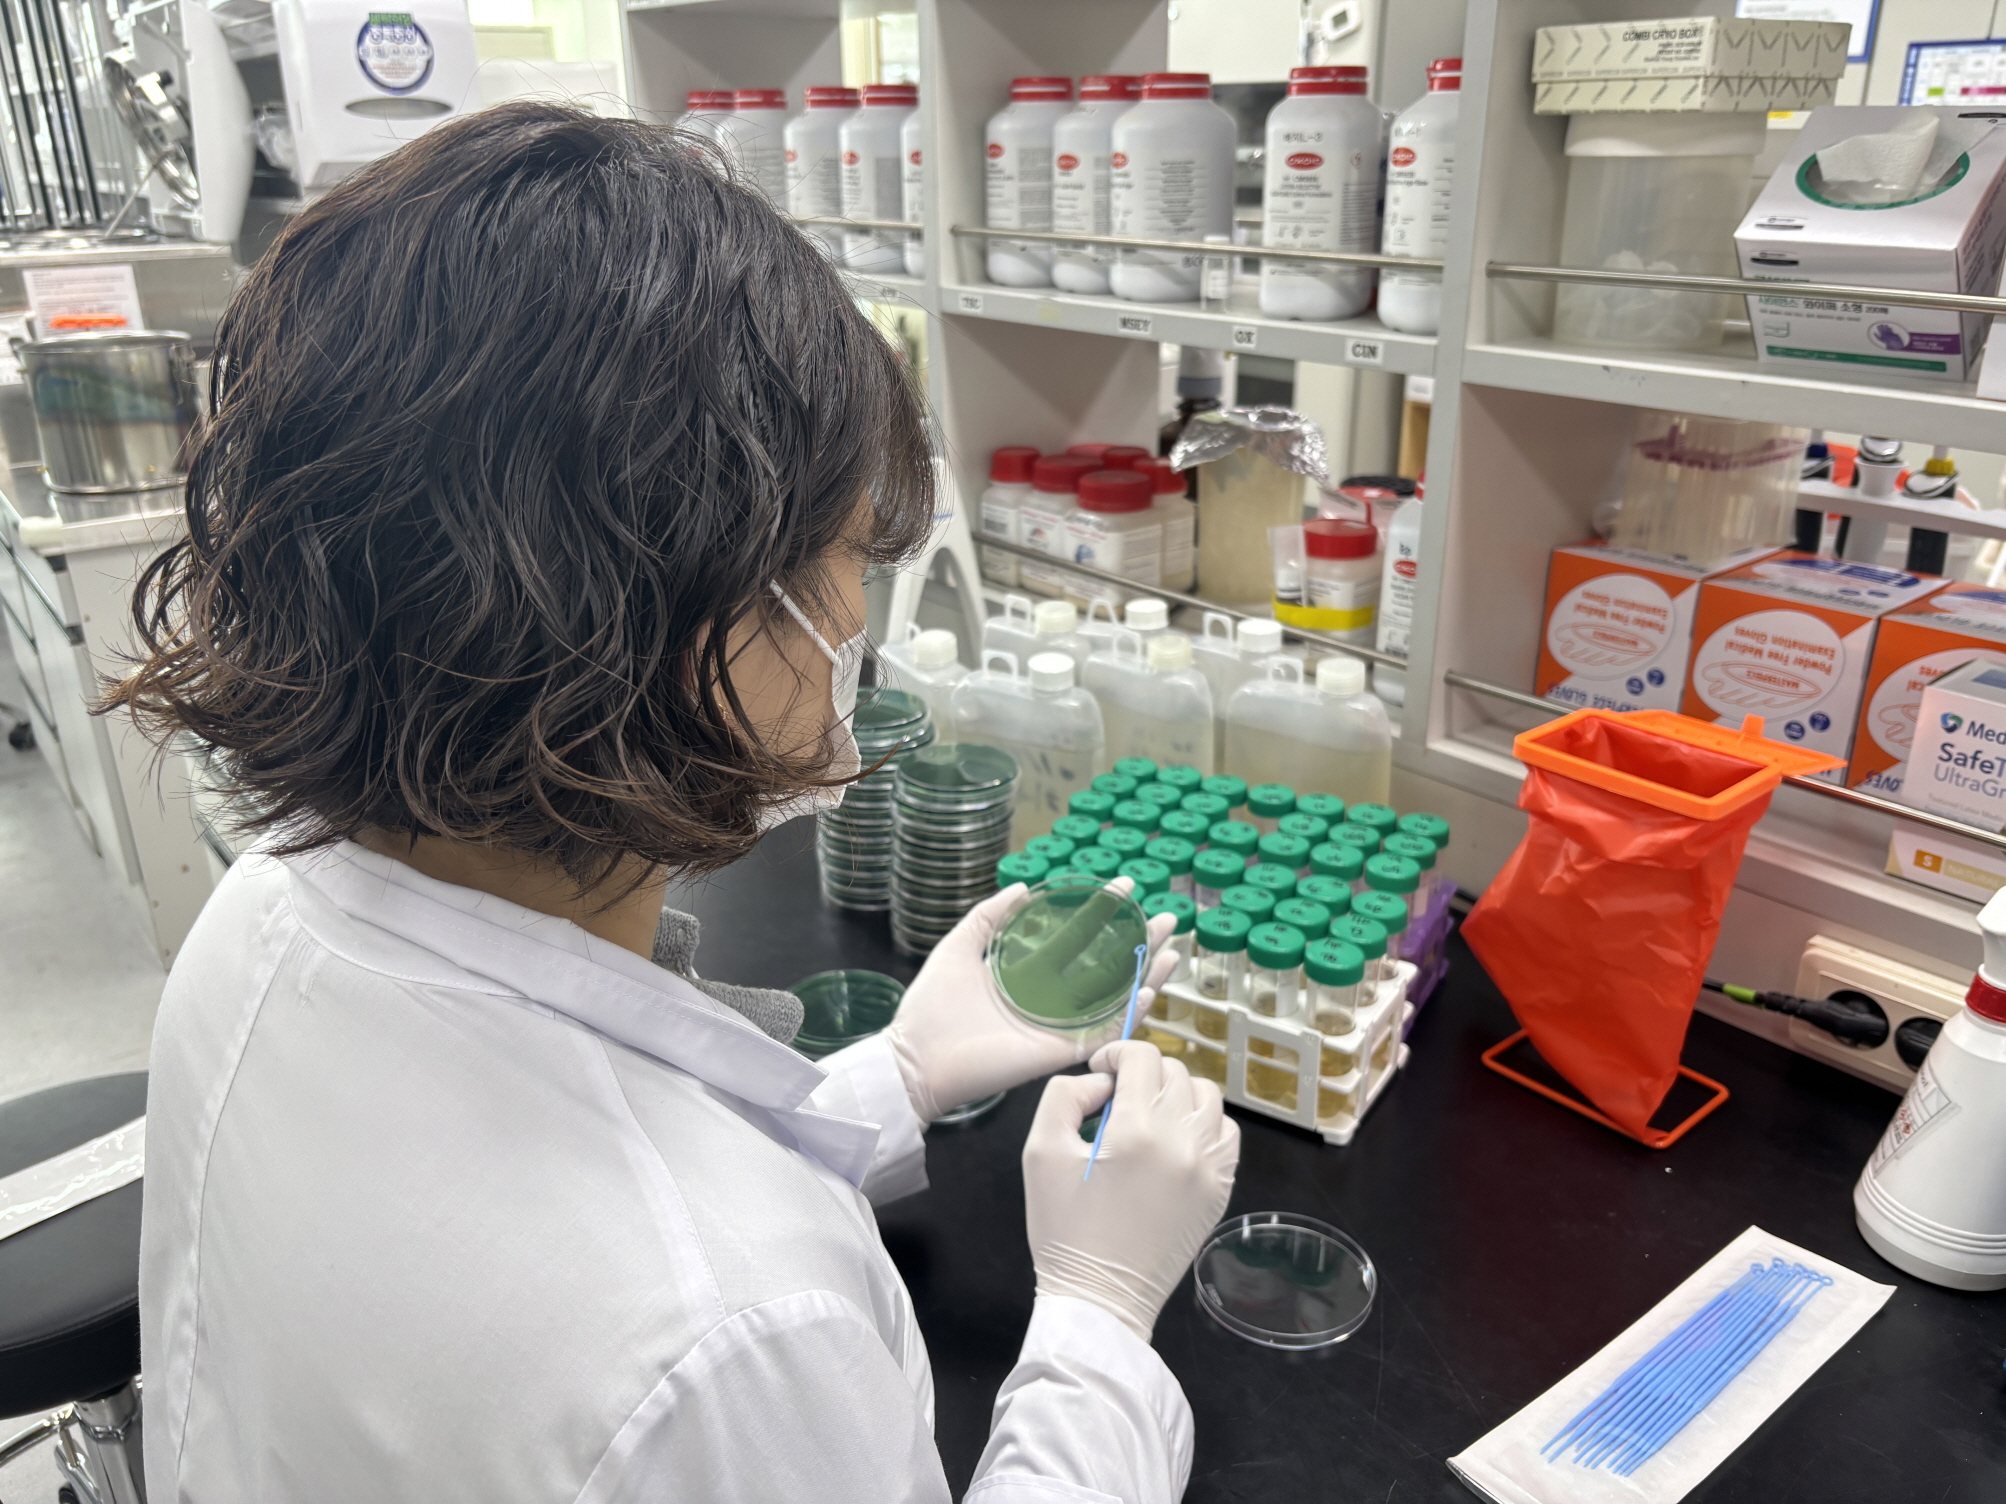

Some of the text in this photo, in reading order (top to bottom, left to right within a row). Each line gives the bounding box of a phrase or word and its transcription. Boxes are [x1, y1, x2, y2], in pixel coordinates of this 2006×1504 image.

[1351, 342, 1380, 359] CIN
[1723, 639, 1834, 676] Powder Free Medical
[1733, 626, 1836, 661] Examination Gloves
[1966, 720, 2006, 746] Med
[1937, 742, 2006, 779] SafeT
[1865, 770, 1902, 795] OVES
[1933, 762, 2006, 800] UltraGr
[1921, 854, 1933, 868] S
